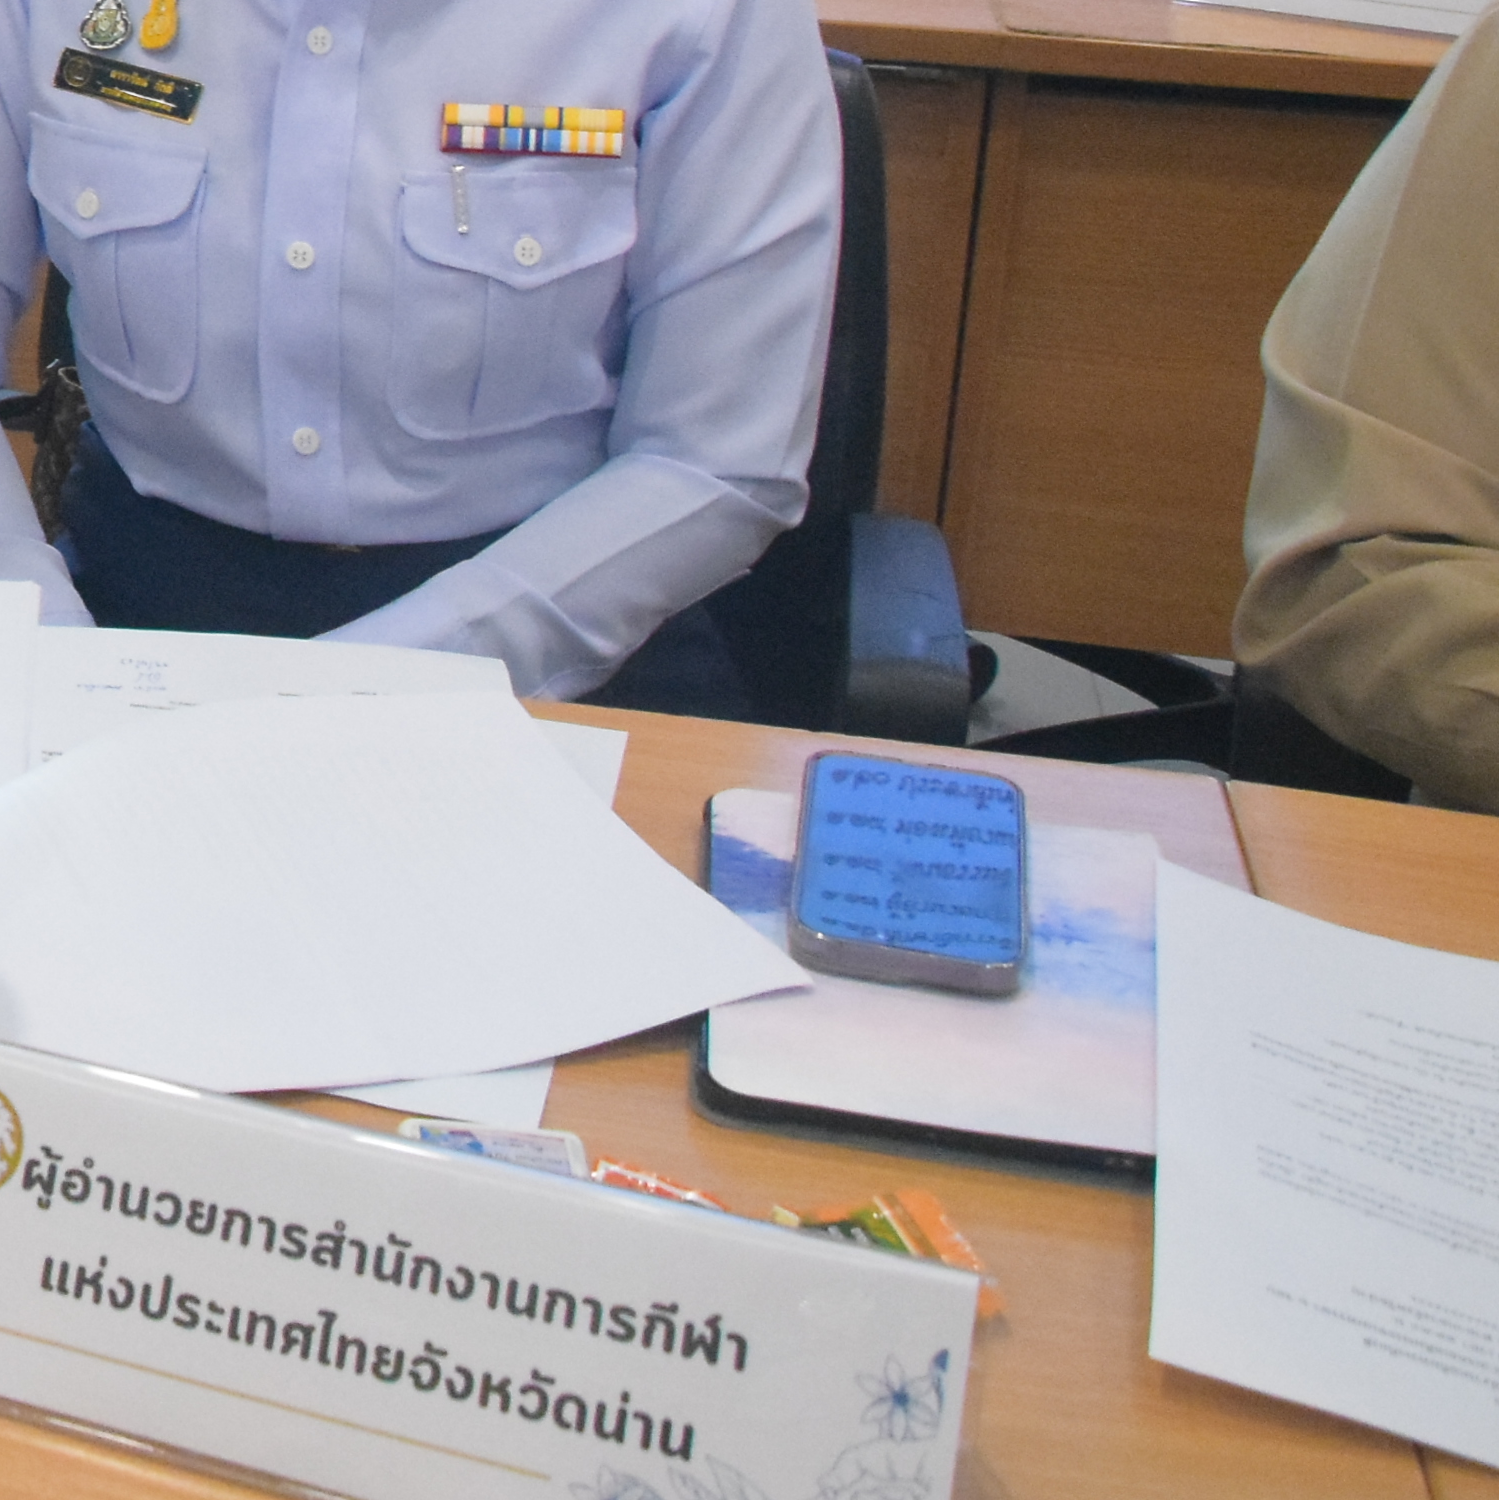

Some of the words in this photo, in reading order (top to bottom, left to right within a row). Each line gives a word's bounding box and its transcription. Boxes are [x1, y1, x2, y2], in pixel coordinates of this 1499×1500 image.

[22, 1145, 749, 1372] ผู้อำนวยการสำนักงานการกีฬา
[40, 1256, 695, 1462] แห่งประเทศไทยจังหวัดน่าน
